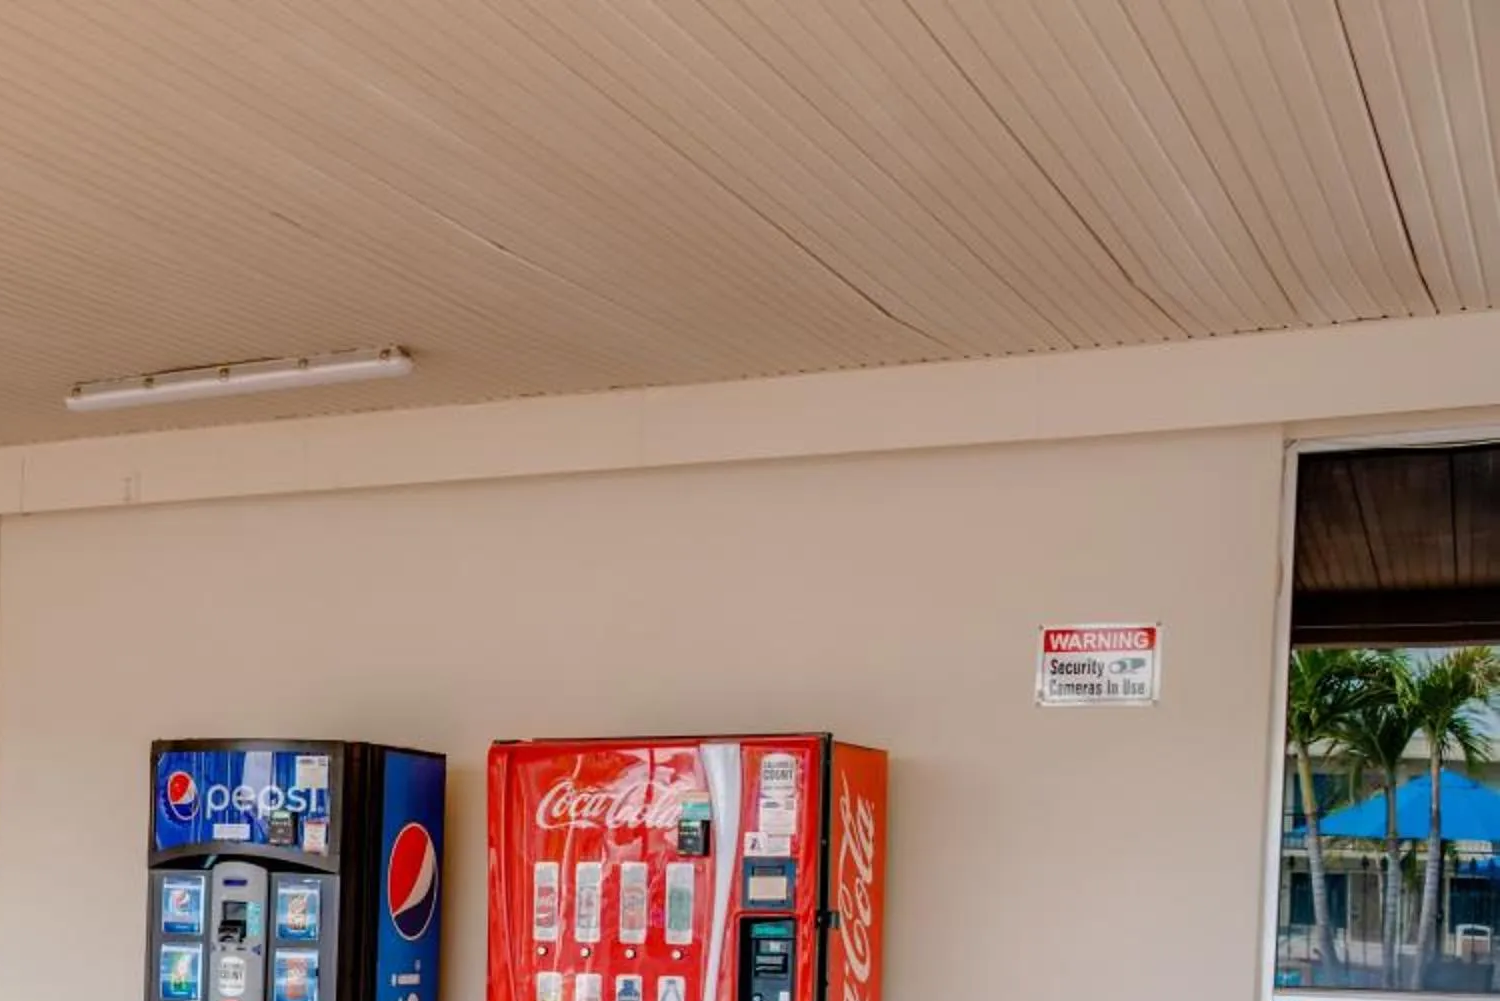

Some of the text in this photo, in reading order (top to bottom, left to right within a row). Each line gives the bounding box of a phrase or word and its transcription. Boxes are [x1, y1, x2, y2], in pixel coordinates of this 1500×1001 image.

[1050, 631, 1150, 650] WARNING
[1051, 658, 1105, 676] Security
[1050, 678, 1145, 696] Cameras In Use
[206, 784, 318, 820] pepsi
